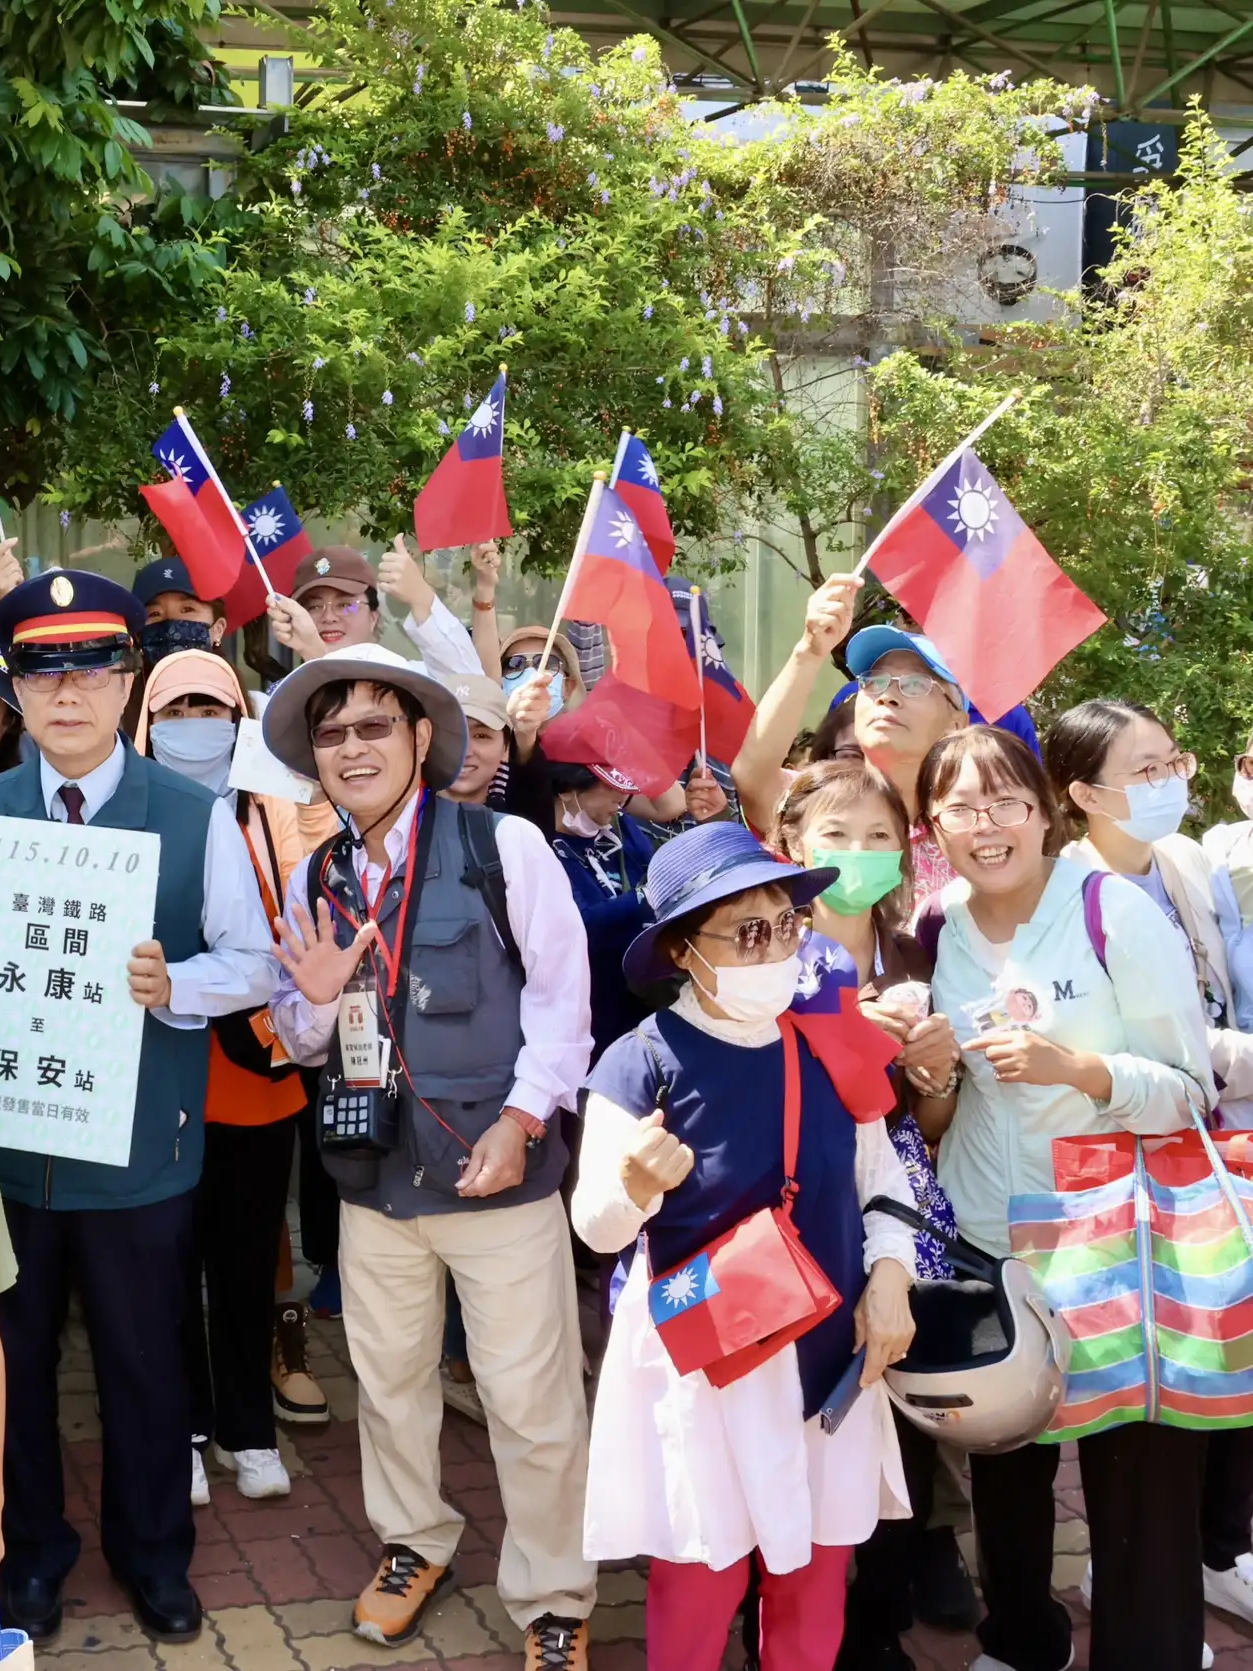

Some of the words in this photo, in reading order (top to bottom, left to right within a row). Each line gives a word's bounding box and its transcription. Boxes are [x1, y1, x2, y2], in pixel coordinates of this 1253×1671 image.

[12, 892, 108, 923] 臺灣鐵路
[24, 922, 90, 957] 區間
[29, 1016, 46, 1034] 至
